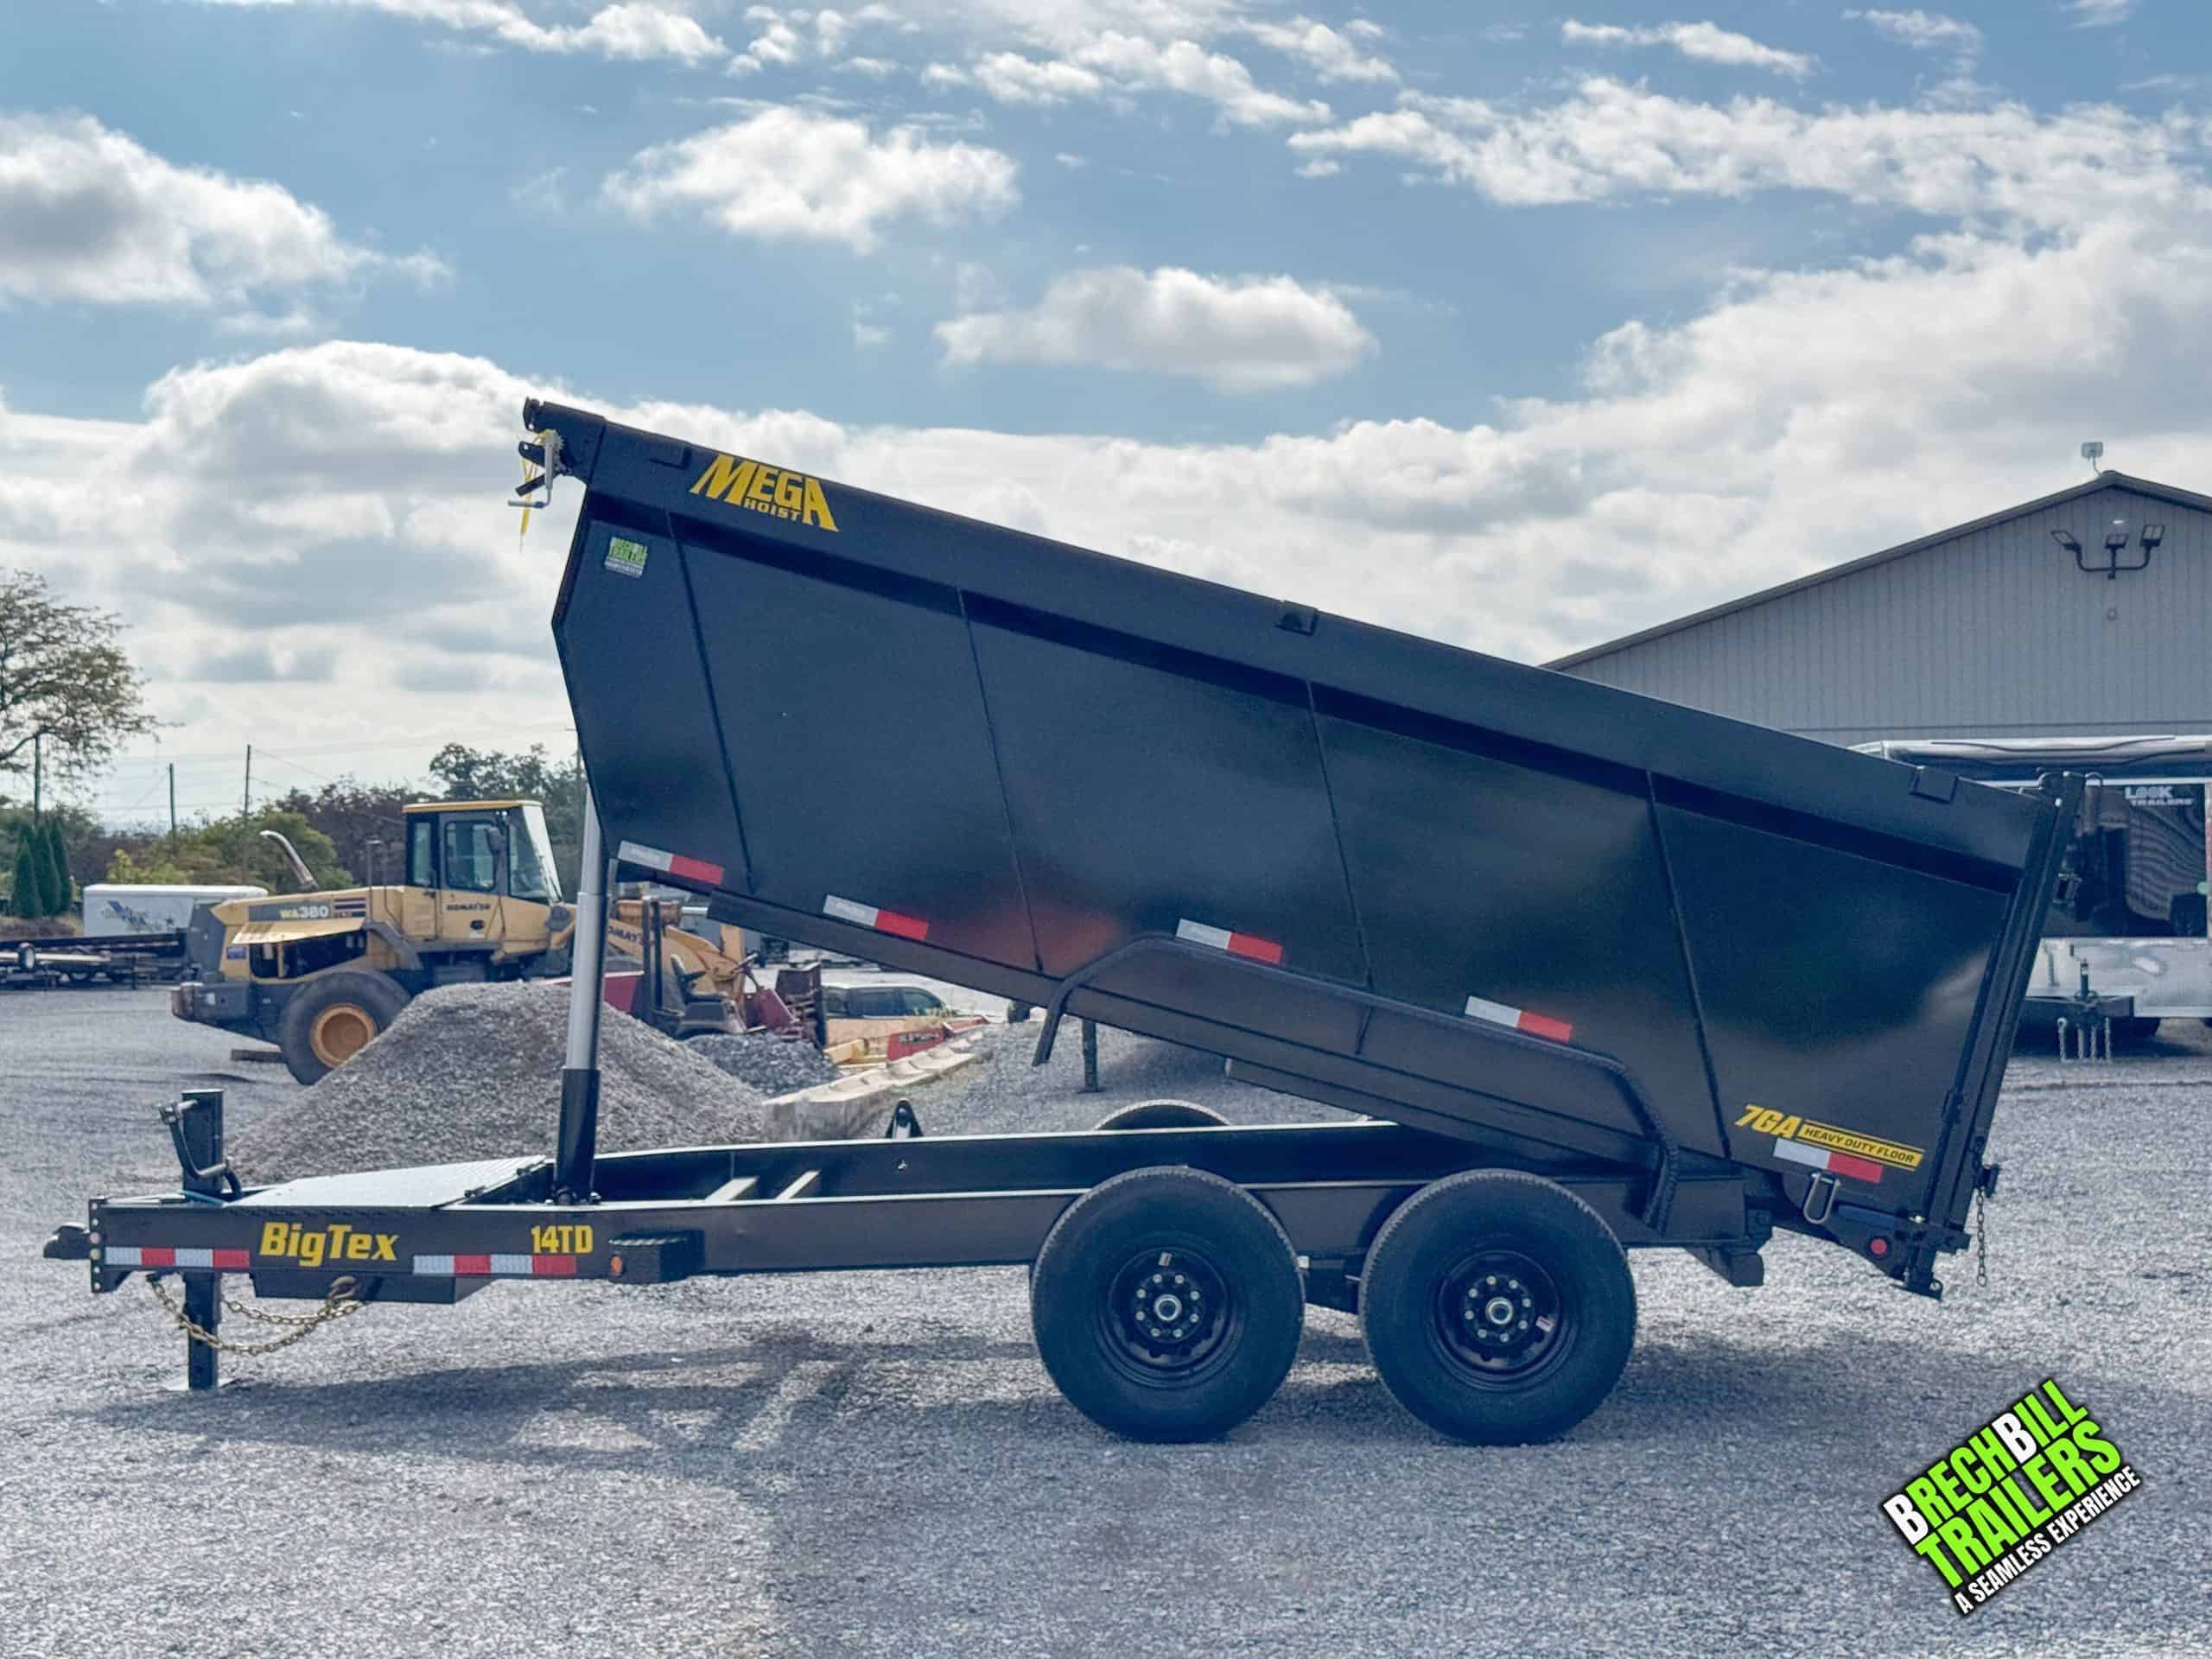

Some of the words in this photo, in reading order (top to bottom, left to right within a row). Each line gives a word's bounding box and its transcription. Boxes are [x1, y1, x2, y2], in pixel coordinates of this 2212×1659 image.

[690, 454, 839, 532] MEGA
[744, 496, 803, 522] HOIST
[280, 905, 329, 919] WA380
[1803, 1127, 1845, 1146] HEAVY
[1844, 1136, 1878, 1154] DUTY
[1876, 1145, 1916, 1164] FLOOR
[260, 1221, 401, 1268] BigTex
[531, 1224, 594, 1255] 14TD
